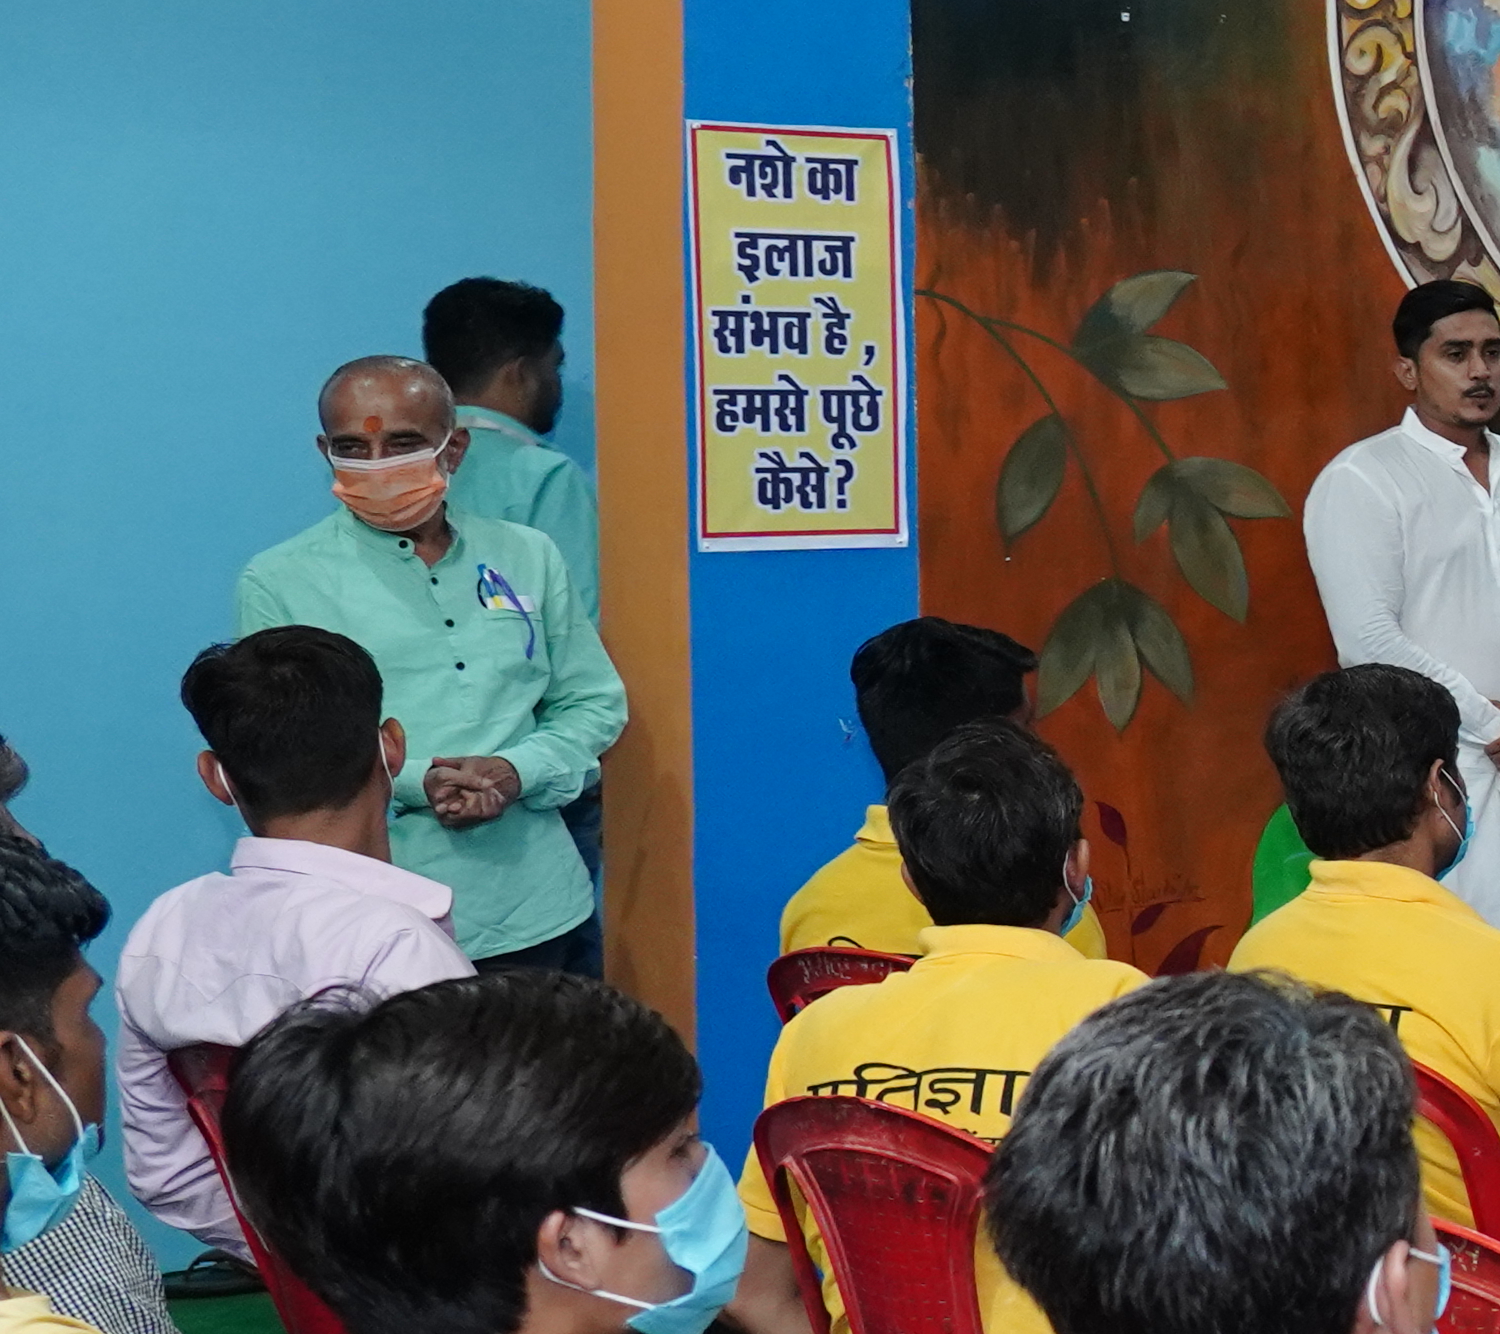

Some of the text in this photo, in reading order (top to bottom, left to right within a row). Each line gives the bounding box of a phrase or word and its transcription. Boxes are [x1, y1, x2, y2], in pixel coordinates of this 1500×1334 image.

[724, 140, 859, 202] नशे का
[733, 231, 856, 284] इलाज
[711, 294, 811, 355] संभव
[712, 373, 883, 450] हमसे पूछे
